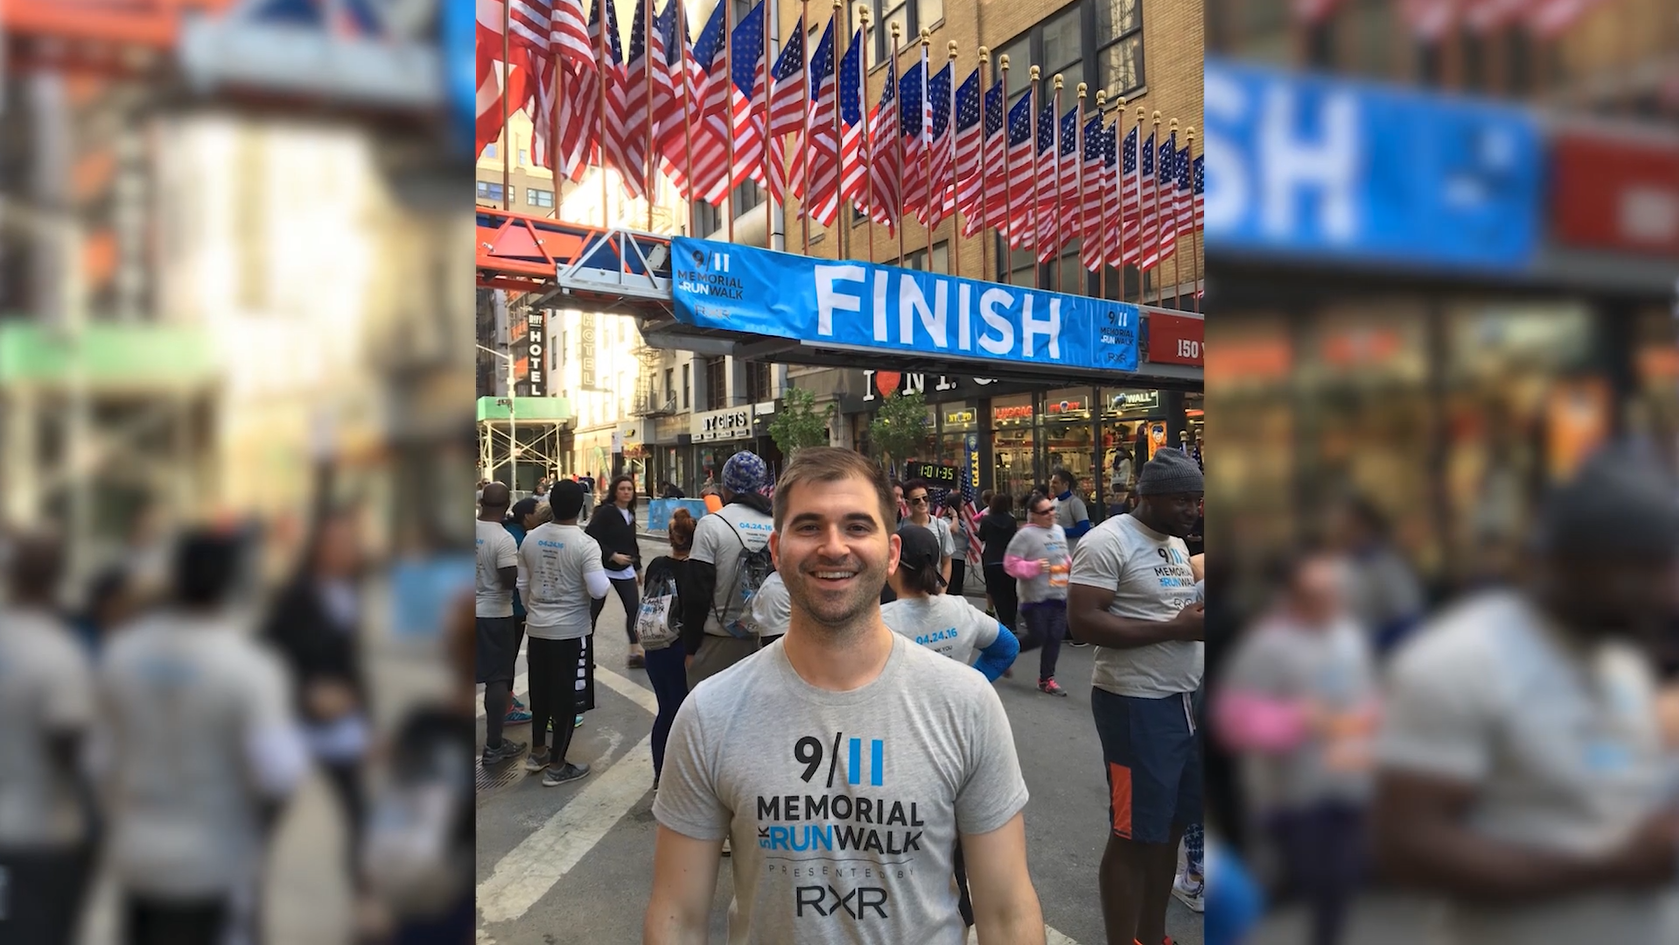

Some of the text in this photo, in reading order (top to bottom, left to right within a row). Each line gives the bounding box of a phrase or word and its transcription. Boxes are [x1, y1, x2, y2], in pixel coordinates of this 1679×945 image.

[692, 249, 730, 272] 9/11
[678, 270, 744, 289] MEMORIAL
[814, 264, 1062, 360] FINISH
[582, 312, 596, 386] HOTEL
[1177, 338, 1199, 359] 150
[529, 331, 542, 396] HOTEL
[1127, 393, 1151, 404] WALL
[718, 411, 746, 428] GIFTS
[970, 451, 979, 487] NYPD
[915, 627, 958, 646] 04.24.16
[794, 731, 884, 789] 9/11
[757, 794, 925, 828] MEMORIAL
[758, 825, 771, 849] 5K
[768, 864, 914, 880] PRESENTED BY
[796, 884, 889, 921] RXR
